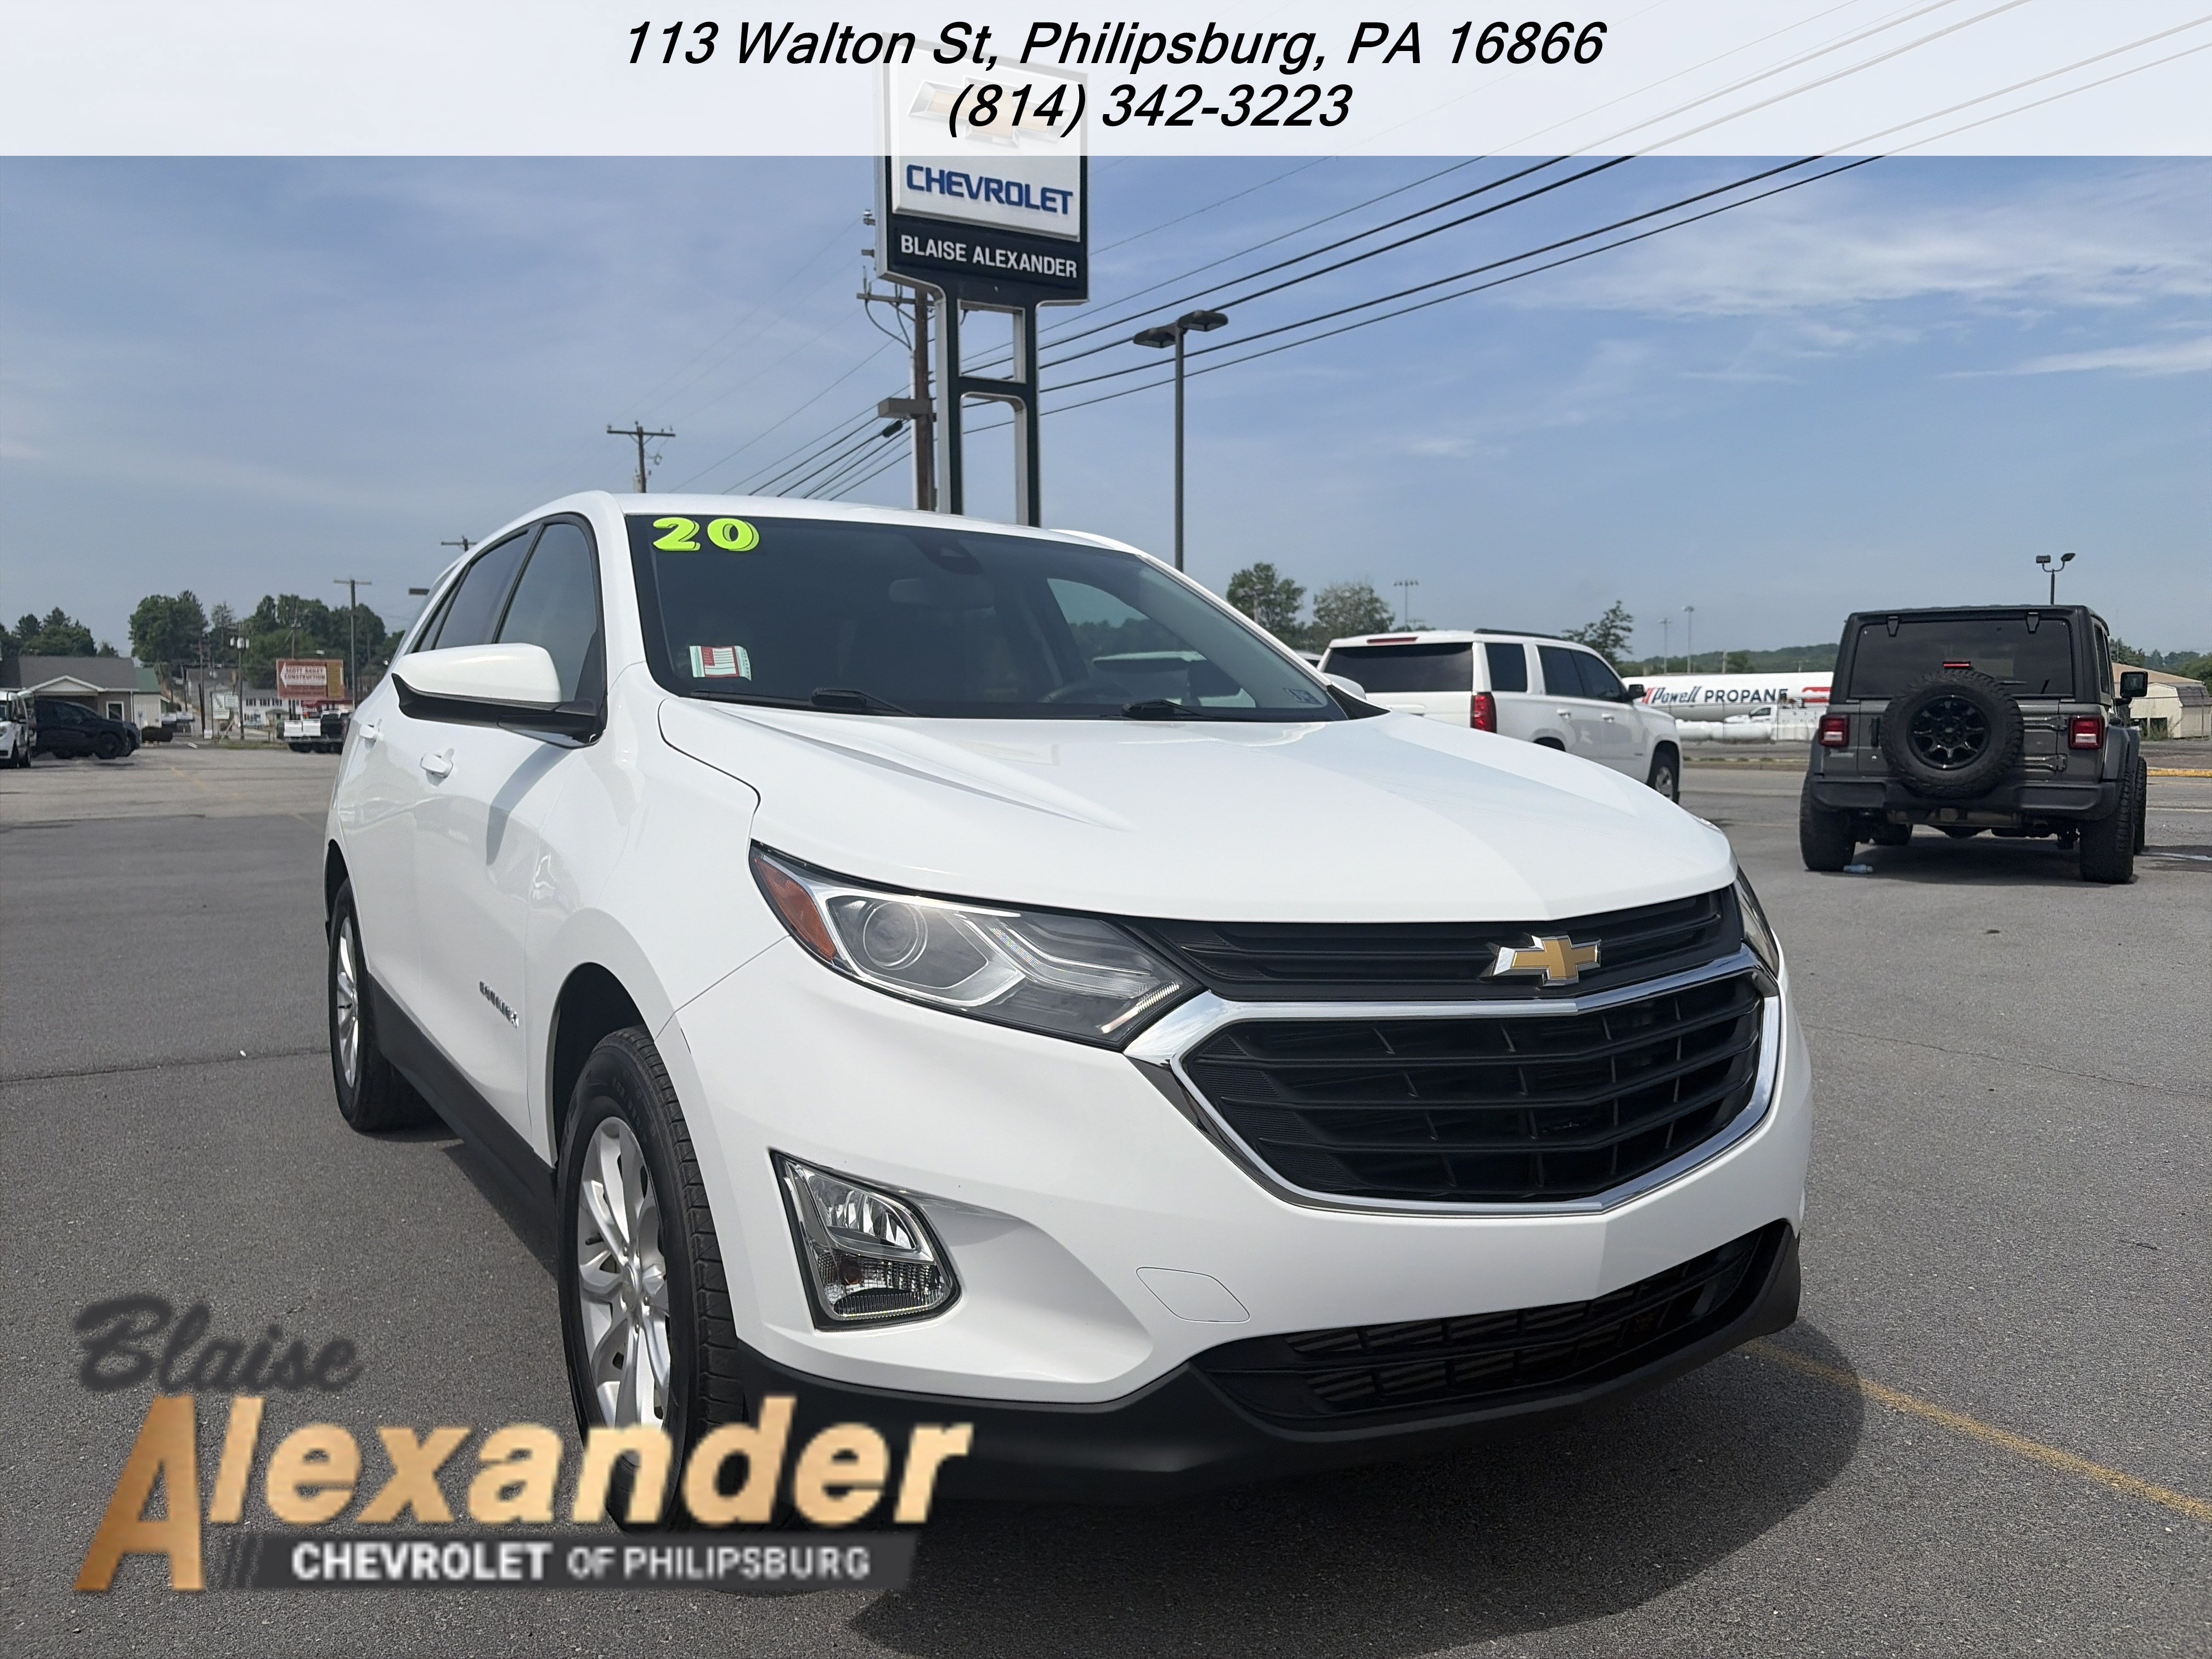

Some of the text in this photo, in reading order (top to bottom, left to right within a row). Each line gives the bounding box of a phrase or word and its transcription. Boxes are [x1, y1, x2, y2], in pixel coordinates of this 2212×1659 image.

[906, 164, 1074, 215] CHEVROLET
[900, 234, 1077, 278] BLAISE ALEXANDER
[653, 517, 760, 552] 20
[1651, 686, 1702, 704] Powell
